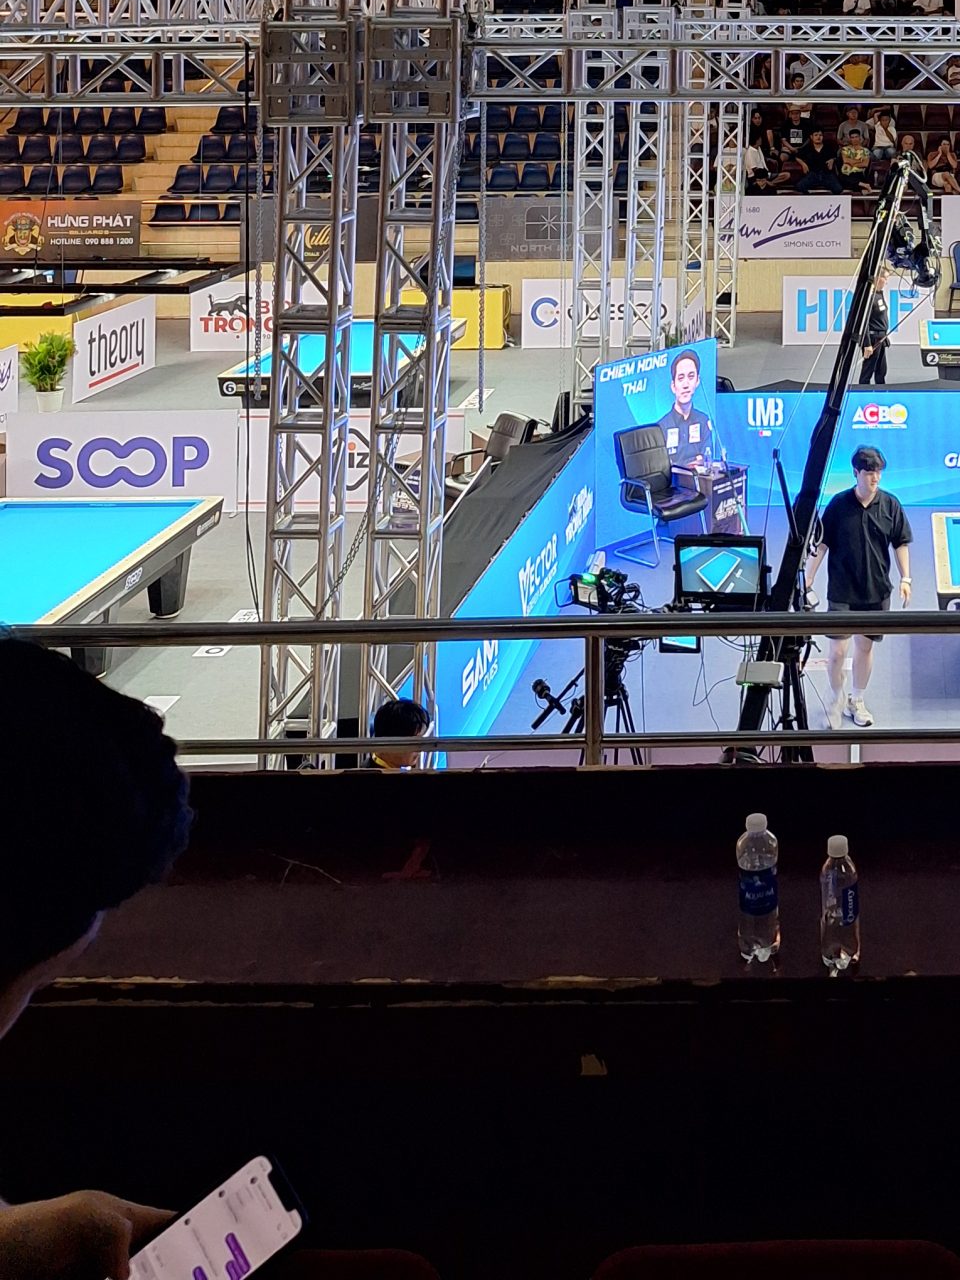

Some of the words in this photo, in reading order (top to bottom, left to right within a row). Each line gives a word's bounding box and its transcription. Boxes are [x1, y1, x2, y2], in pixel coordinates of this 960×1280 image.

[93, 212, 133, 227] PHÁT
[87, 317, 146, 377] theory
[600, 360, 635, 382] CHIEM
[637, 353, 668, 373] HONG
[225, 383, 235, 393] 6
[622, 378, 648, 397] THAI
[34, 436, 210, 490] SOOP
